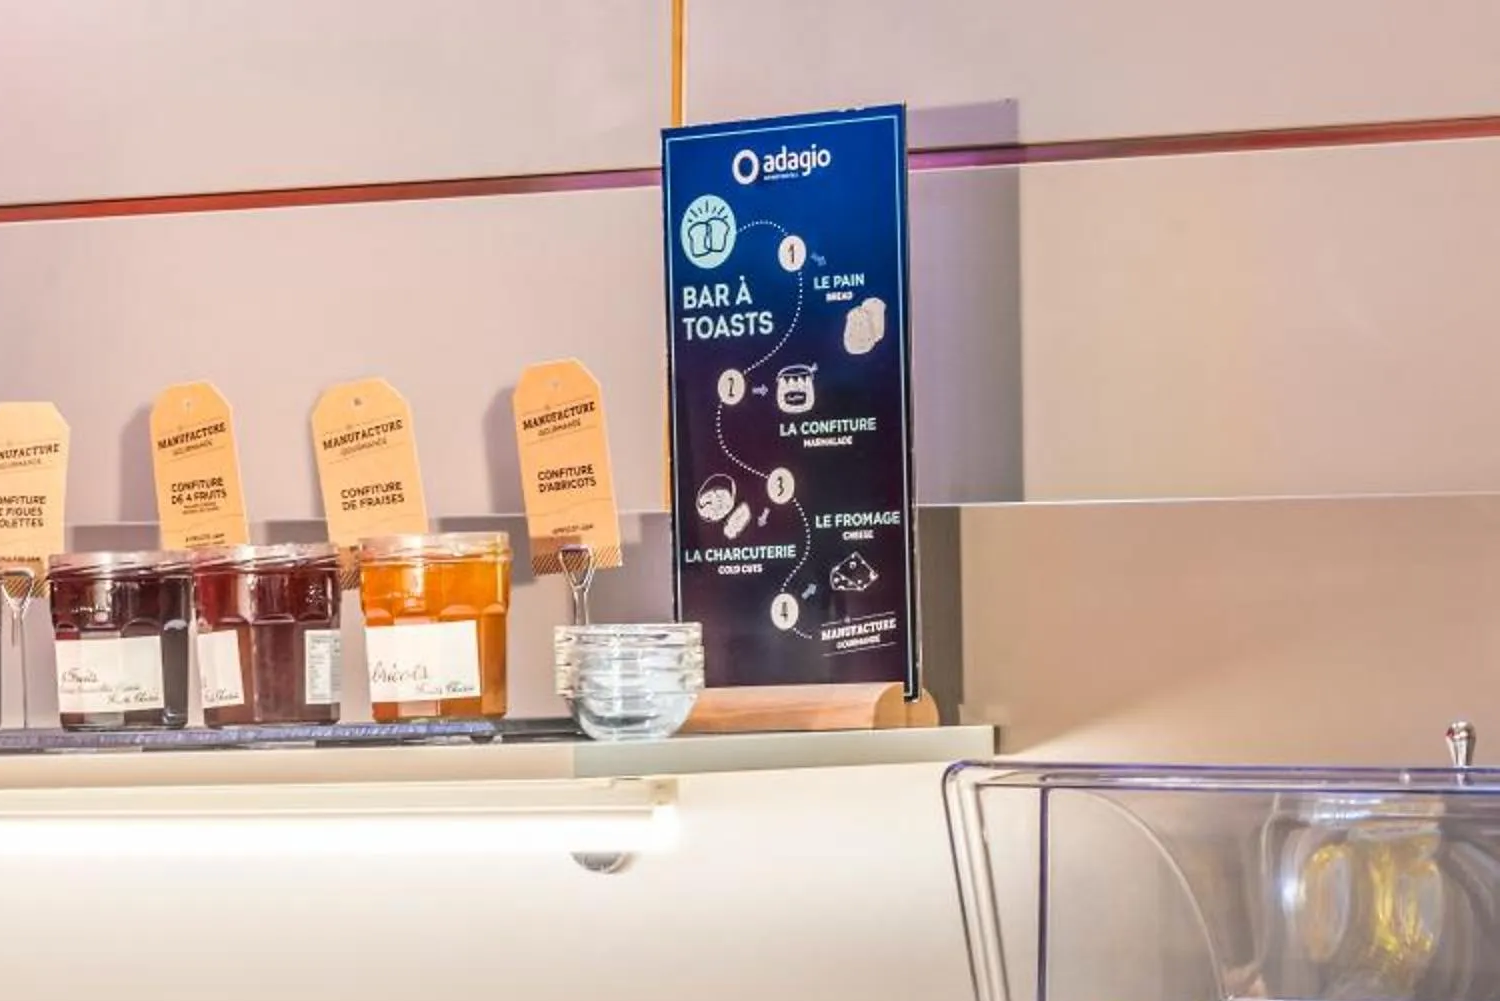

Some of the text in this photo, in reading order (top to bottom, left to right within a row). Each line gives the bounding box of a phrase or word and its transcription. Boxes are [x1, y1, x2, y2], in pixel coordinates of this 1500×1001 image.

[764, 144, 831, 177] adagio
[814, 273, 865, 290] LE PAIN
[683, 275, 753, 309] BAR À
[683, 311, 774, 341] TOASTS
[322, 419, 404, 450] MANUFACTURE
[779, 418, 877, 436] LA CONFITURE
[537, 464, 595, 481] CONFITURE
[172, 477, 224, 493] CONFITURE
[340, 481, 403, 499] CONFITURE
[172, 494, 184, 505] DE
[193, 488, 227, 503] FRUITS
[342, 493, 405, 511] DE FRAISES
[5, 507, 43, 517] FIGUES
[815, 511, 901, 528] LE FROMAGE
[685, 544, 797, 563] LA CHARCUTERIE
[821, 618, 896, 640] MANUFACTURE
